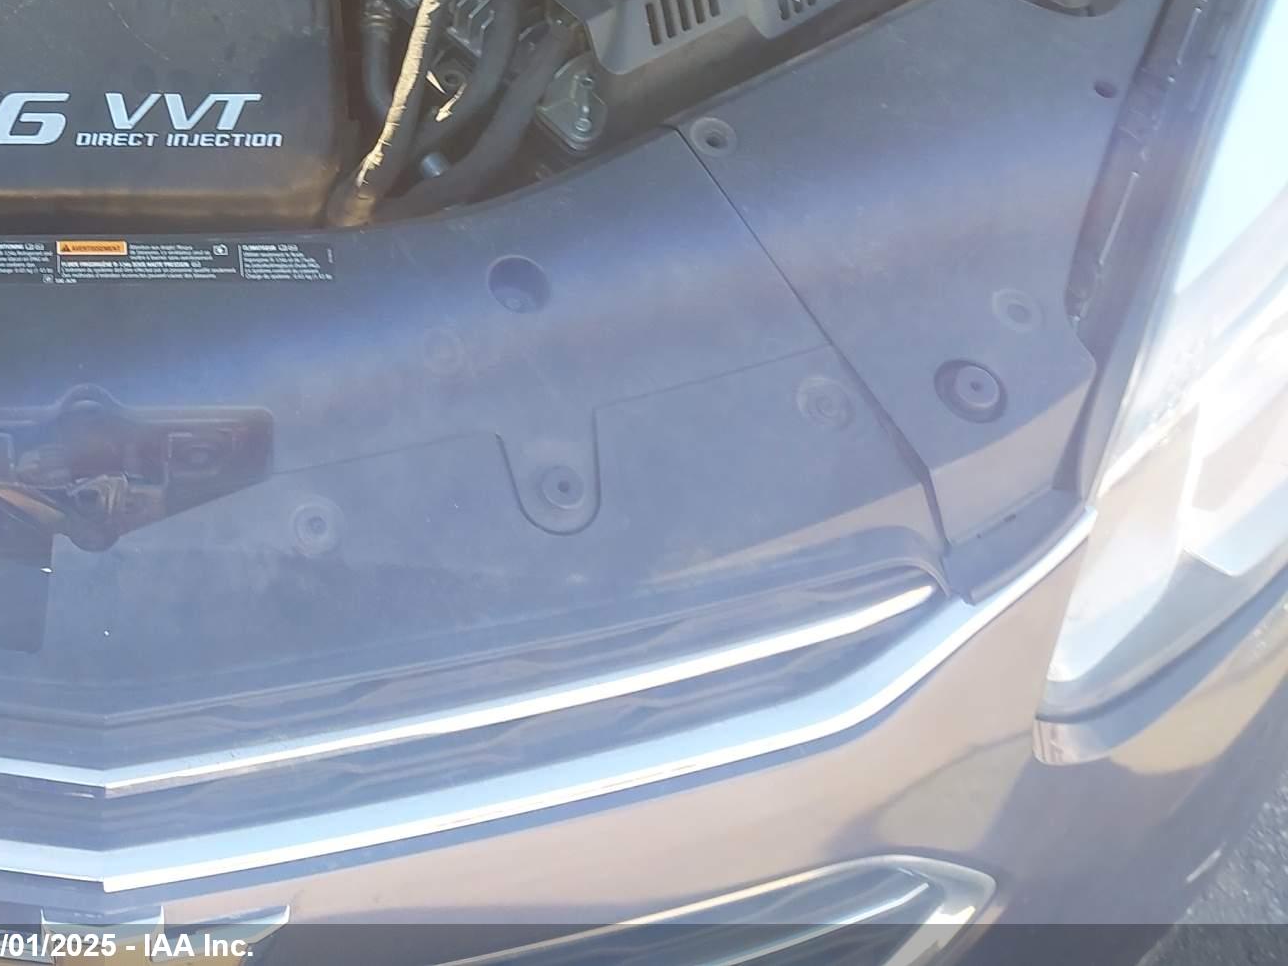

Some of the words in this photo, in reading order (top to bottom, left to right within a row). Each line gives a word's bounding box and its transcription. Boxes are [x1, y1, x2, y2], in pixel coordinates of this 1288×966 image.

[104, 92, 263, 131] VVT
[75, 132, 160, 148] DIRECT
[166, 132, 283, 148] INJECTION
